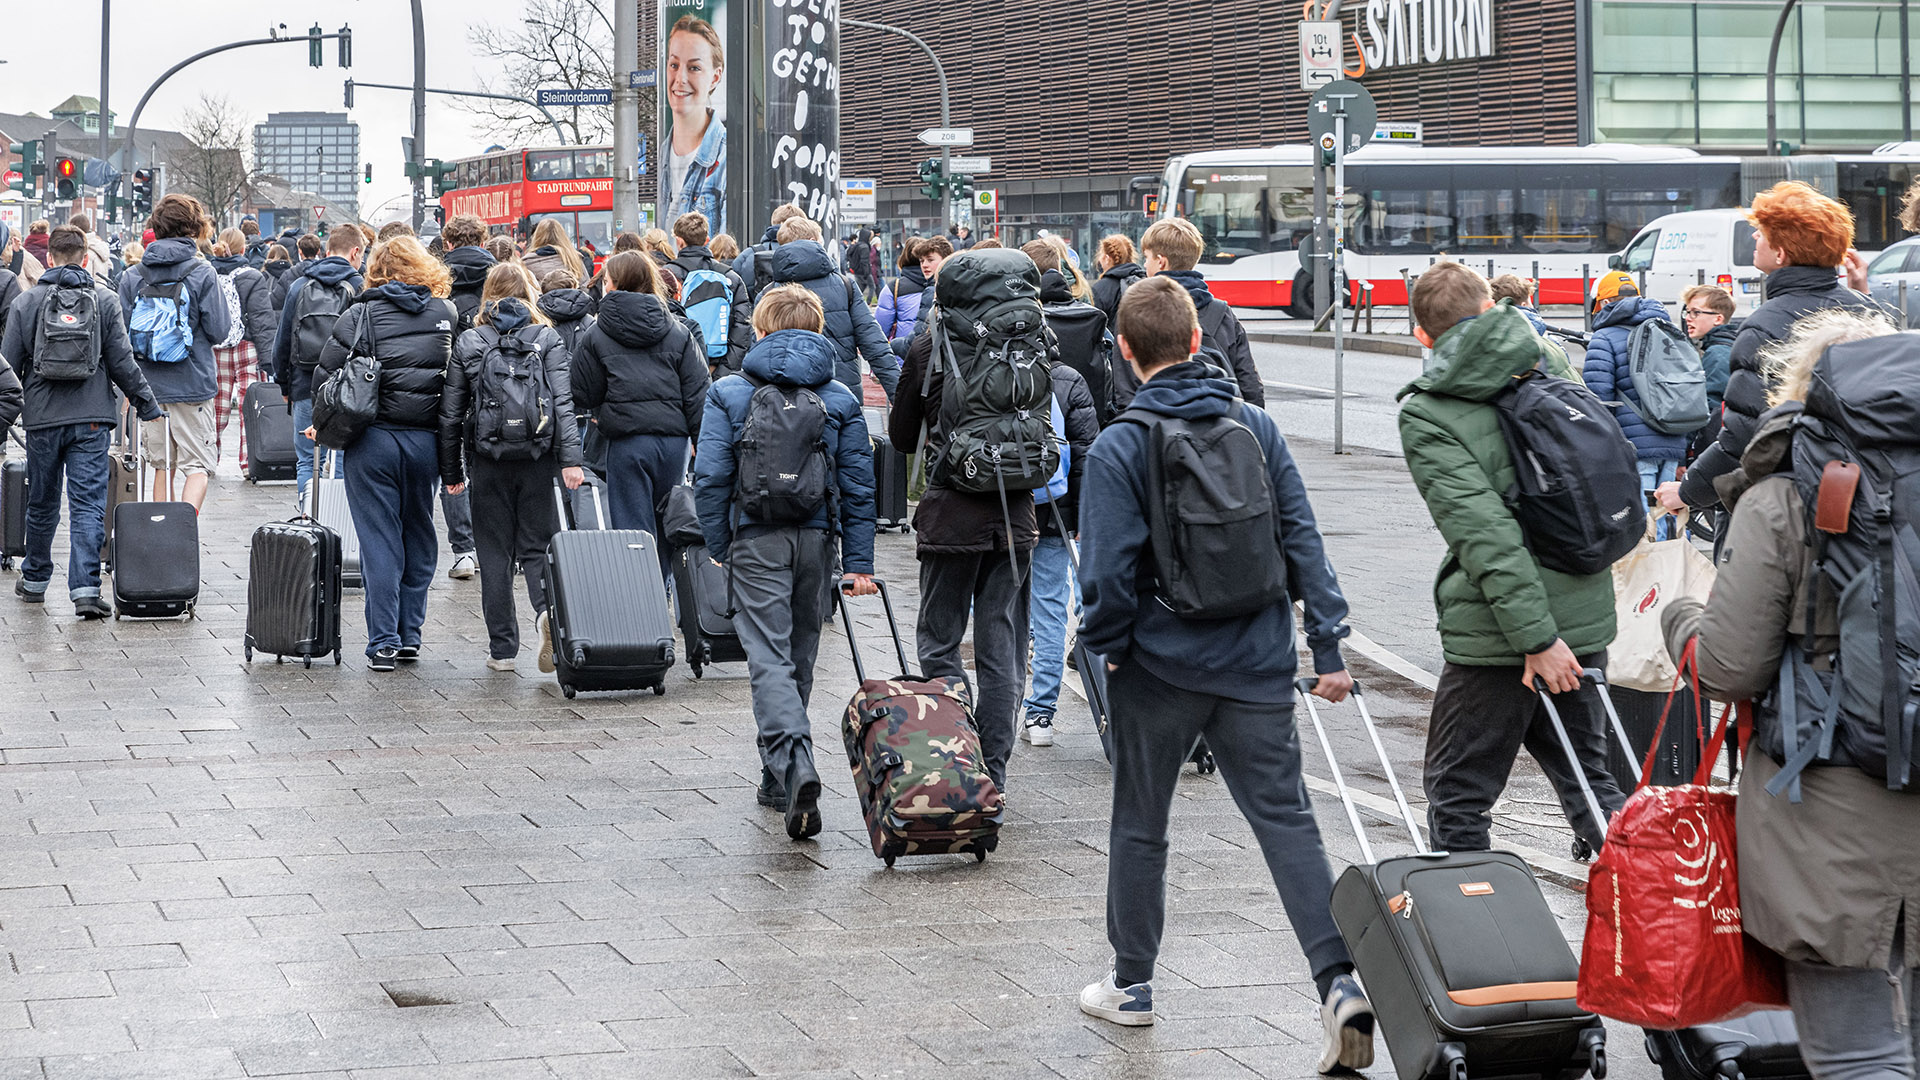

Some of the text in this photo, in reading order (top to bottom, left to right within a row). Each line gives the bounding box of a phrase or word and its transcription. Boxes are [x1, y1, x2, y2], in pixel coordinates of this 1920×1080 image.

[787, 14, 826, 46] TO
[1366, 0, 1491, 70] SATURN
[541, 90, 608, 103] Steintordamm
[941, 133, 956, 141] ZOB
[537, 180, 613, 194] STADTRUNDFAHRT
